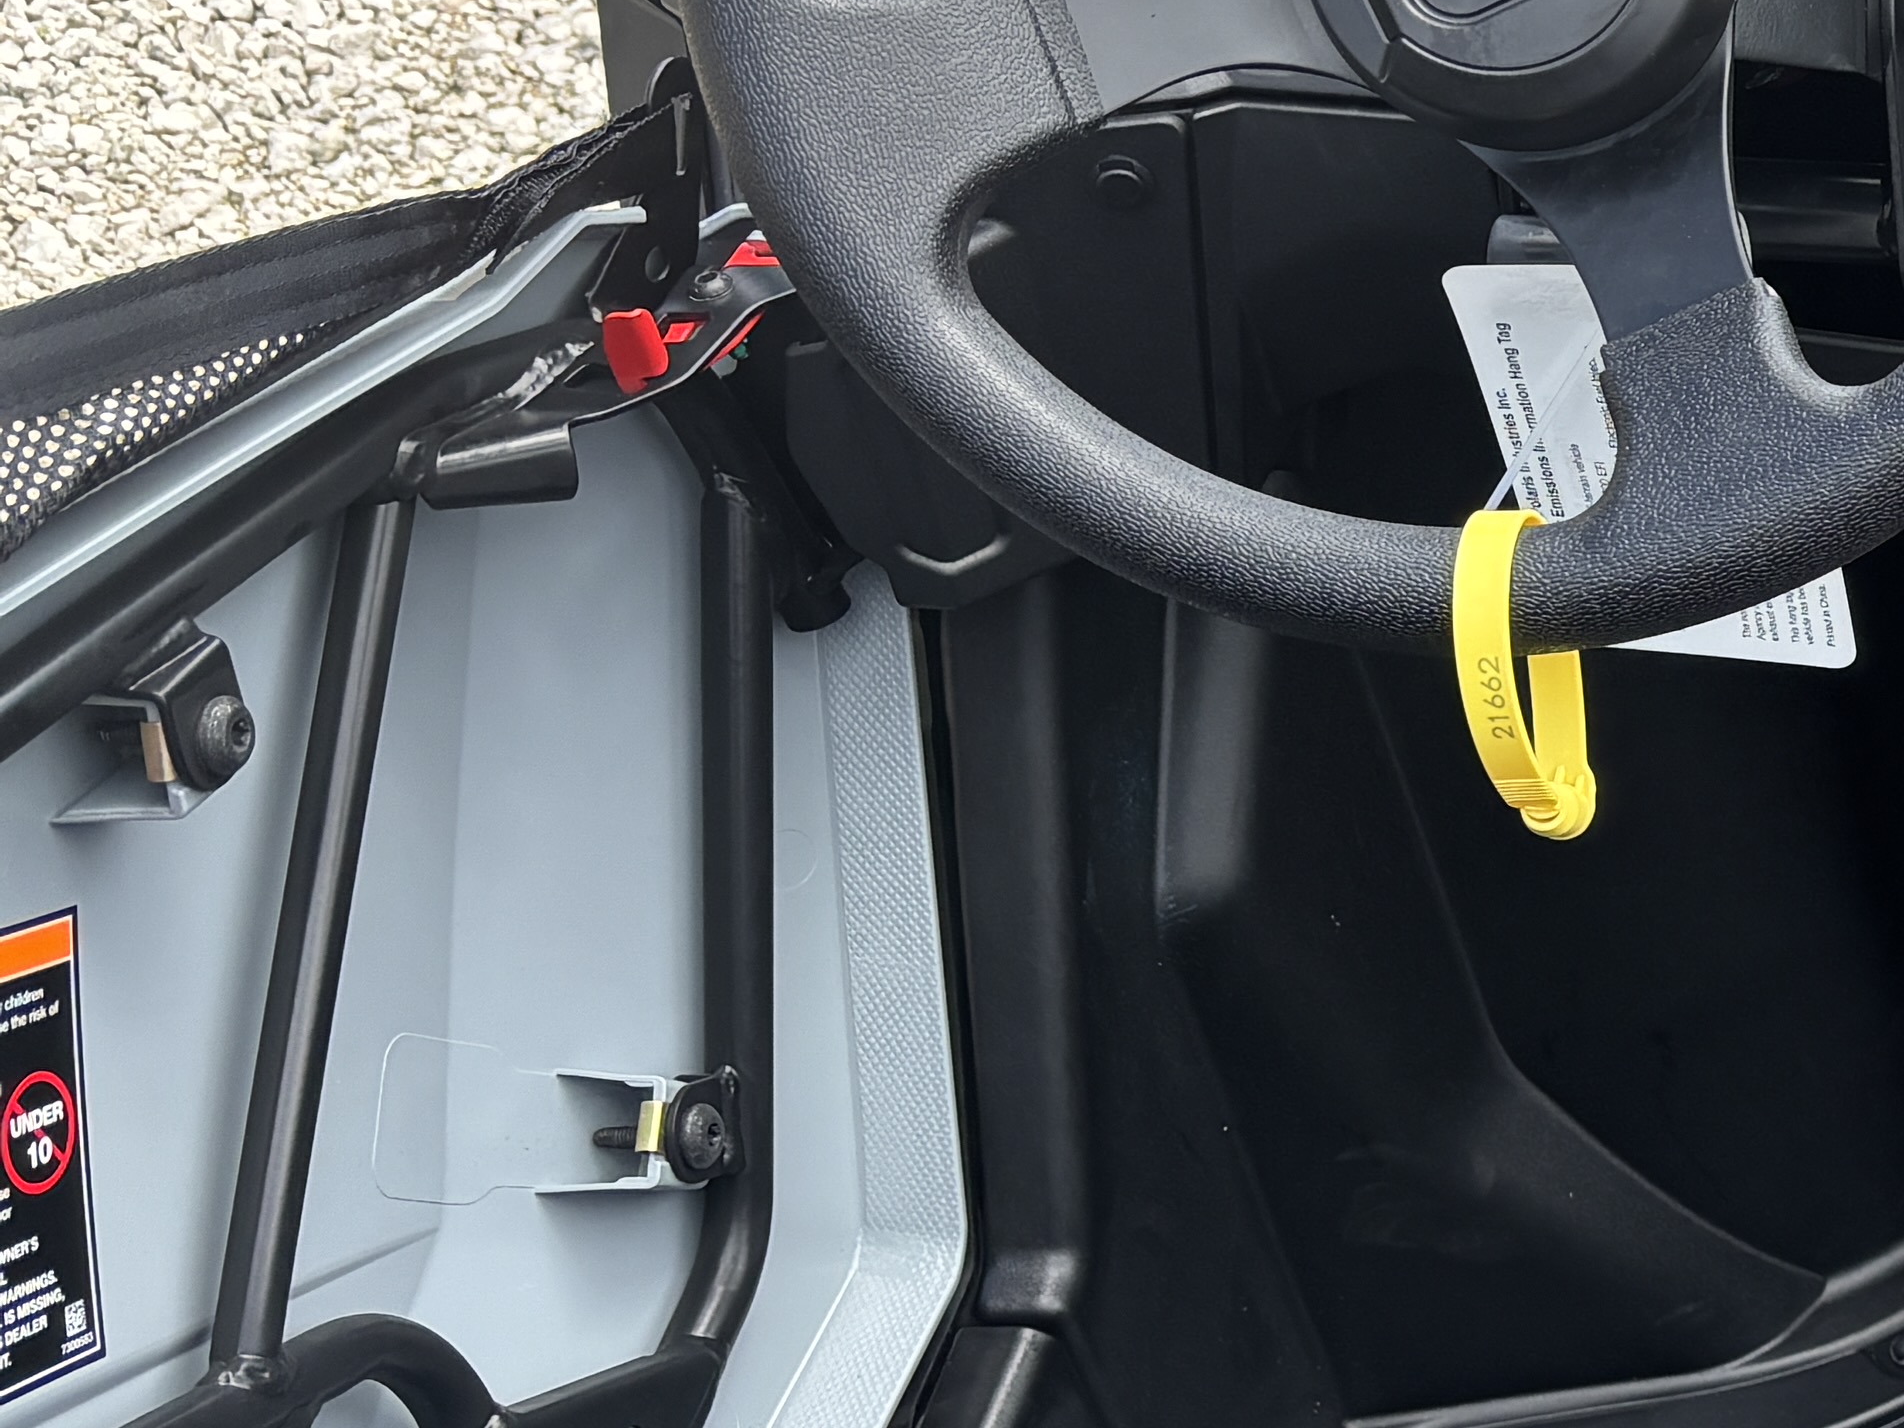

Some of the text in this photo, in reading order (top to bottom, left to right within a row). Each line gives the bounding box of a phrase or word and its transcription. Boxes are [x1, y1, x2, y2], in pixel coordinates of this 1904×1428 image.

[1496, 388, 1511, 409] Inc.
[1495, 322, 1565, 518] Emissions Inrmation Hang Tag
[1522, 476, 1542, 510] olaris
[1477, 656, 1515, 740] 21662
[4, 988, 44, 1011] children
[10, 1000, 59, 1030] the risk of
[10, 1100, 64, 1139] UNDER
[27, 1135, 53, 1169] 10
[4, 1287, 66, 1326] IS MISSING,
[5, 1314, 48, 1346] DEALER
